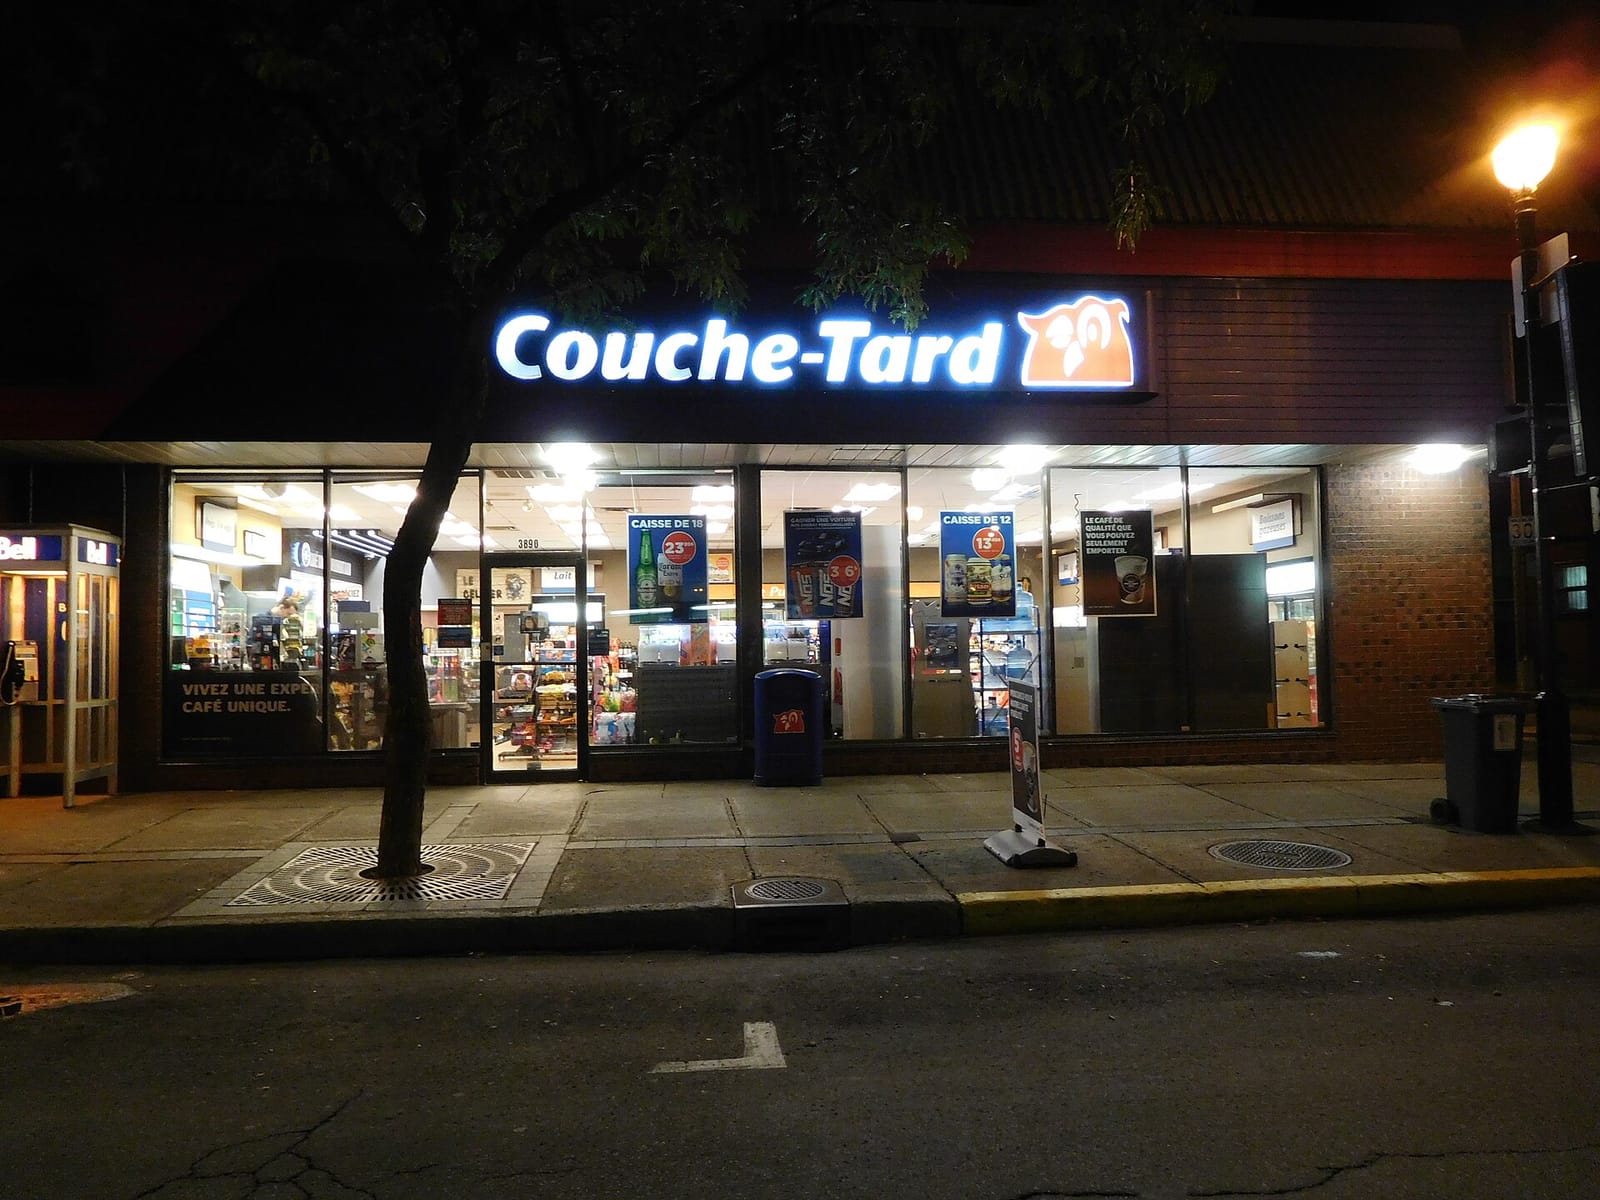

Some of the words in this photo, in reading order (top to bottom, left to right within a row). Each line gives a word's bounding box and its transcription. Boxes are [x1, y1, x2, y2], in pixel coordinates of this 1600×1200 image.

[495, 313, 1004, 385] Couche-Tard
[631, 519, 672, 529] CAISSE
[674, 519, 690, 528] DE
[691, 519, 704, 528] 18
[943, 515, 982, 524] CAISSE
[983, 515, 998, 524] DE
[999, 515, 1012, 524] 12
[1095, 516, 1114, 524] CAFÉ
[1085, 524, 1116, 532] QUALITÉ
[1116, 524, 1132, 532] QUE
[518, 539, 539, 549] 3890
[665, 541, 686, 554] 23
[554, 571, 572, 580] Lait
[830, 566, 840, 577] 3
[463, 575, 474, 585] LE
[463, 589, 503, 599] CELER
[182, 683, 229, 696] VIVEZ
[234, 683, 265, 696] UNE
[182, 699, 222, 713] CAFÉ
[227, 700, 292, 714] UNIQUE.
